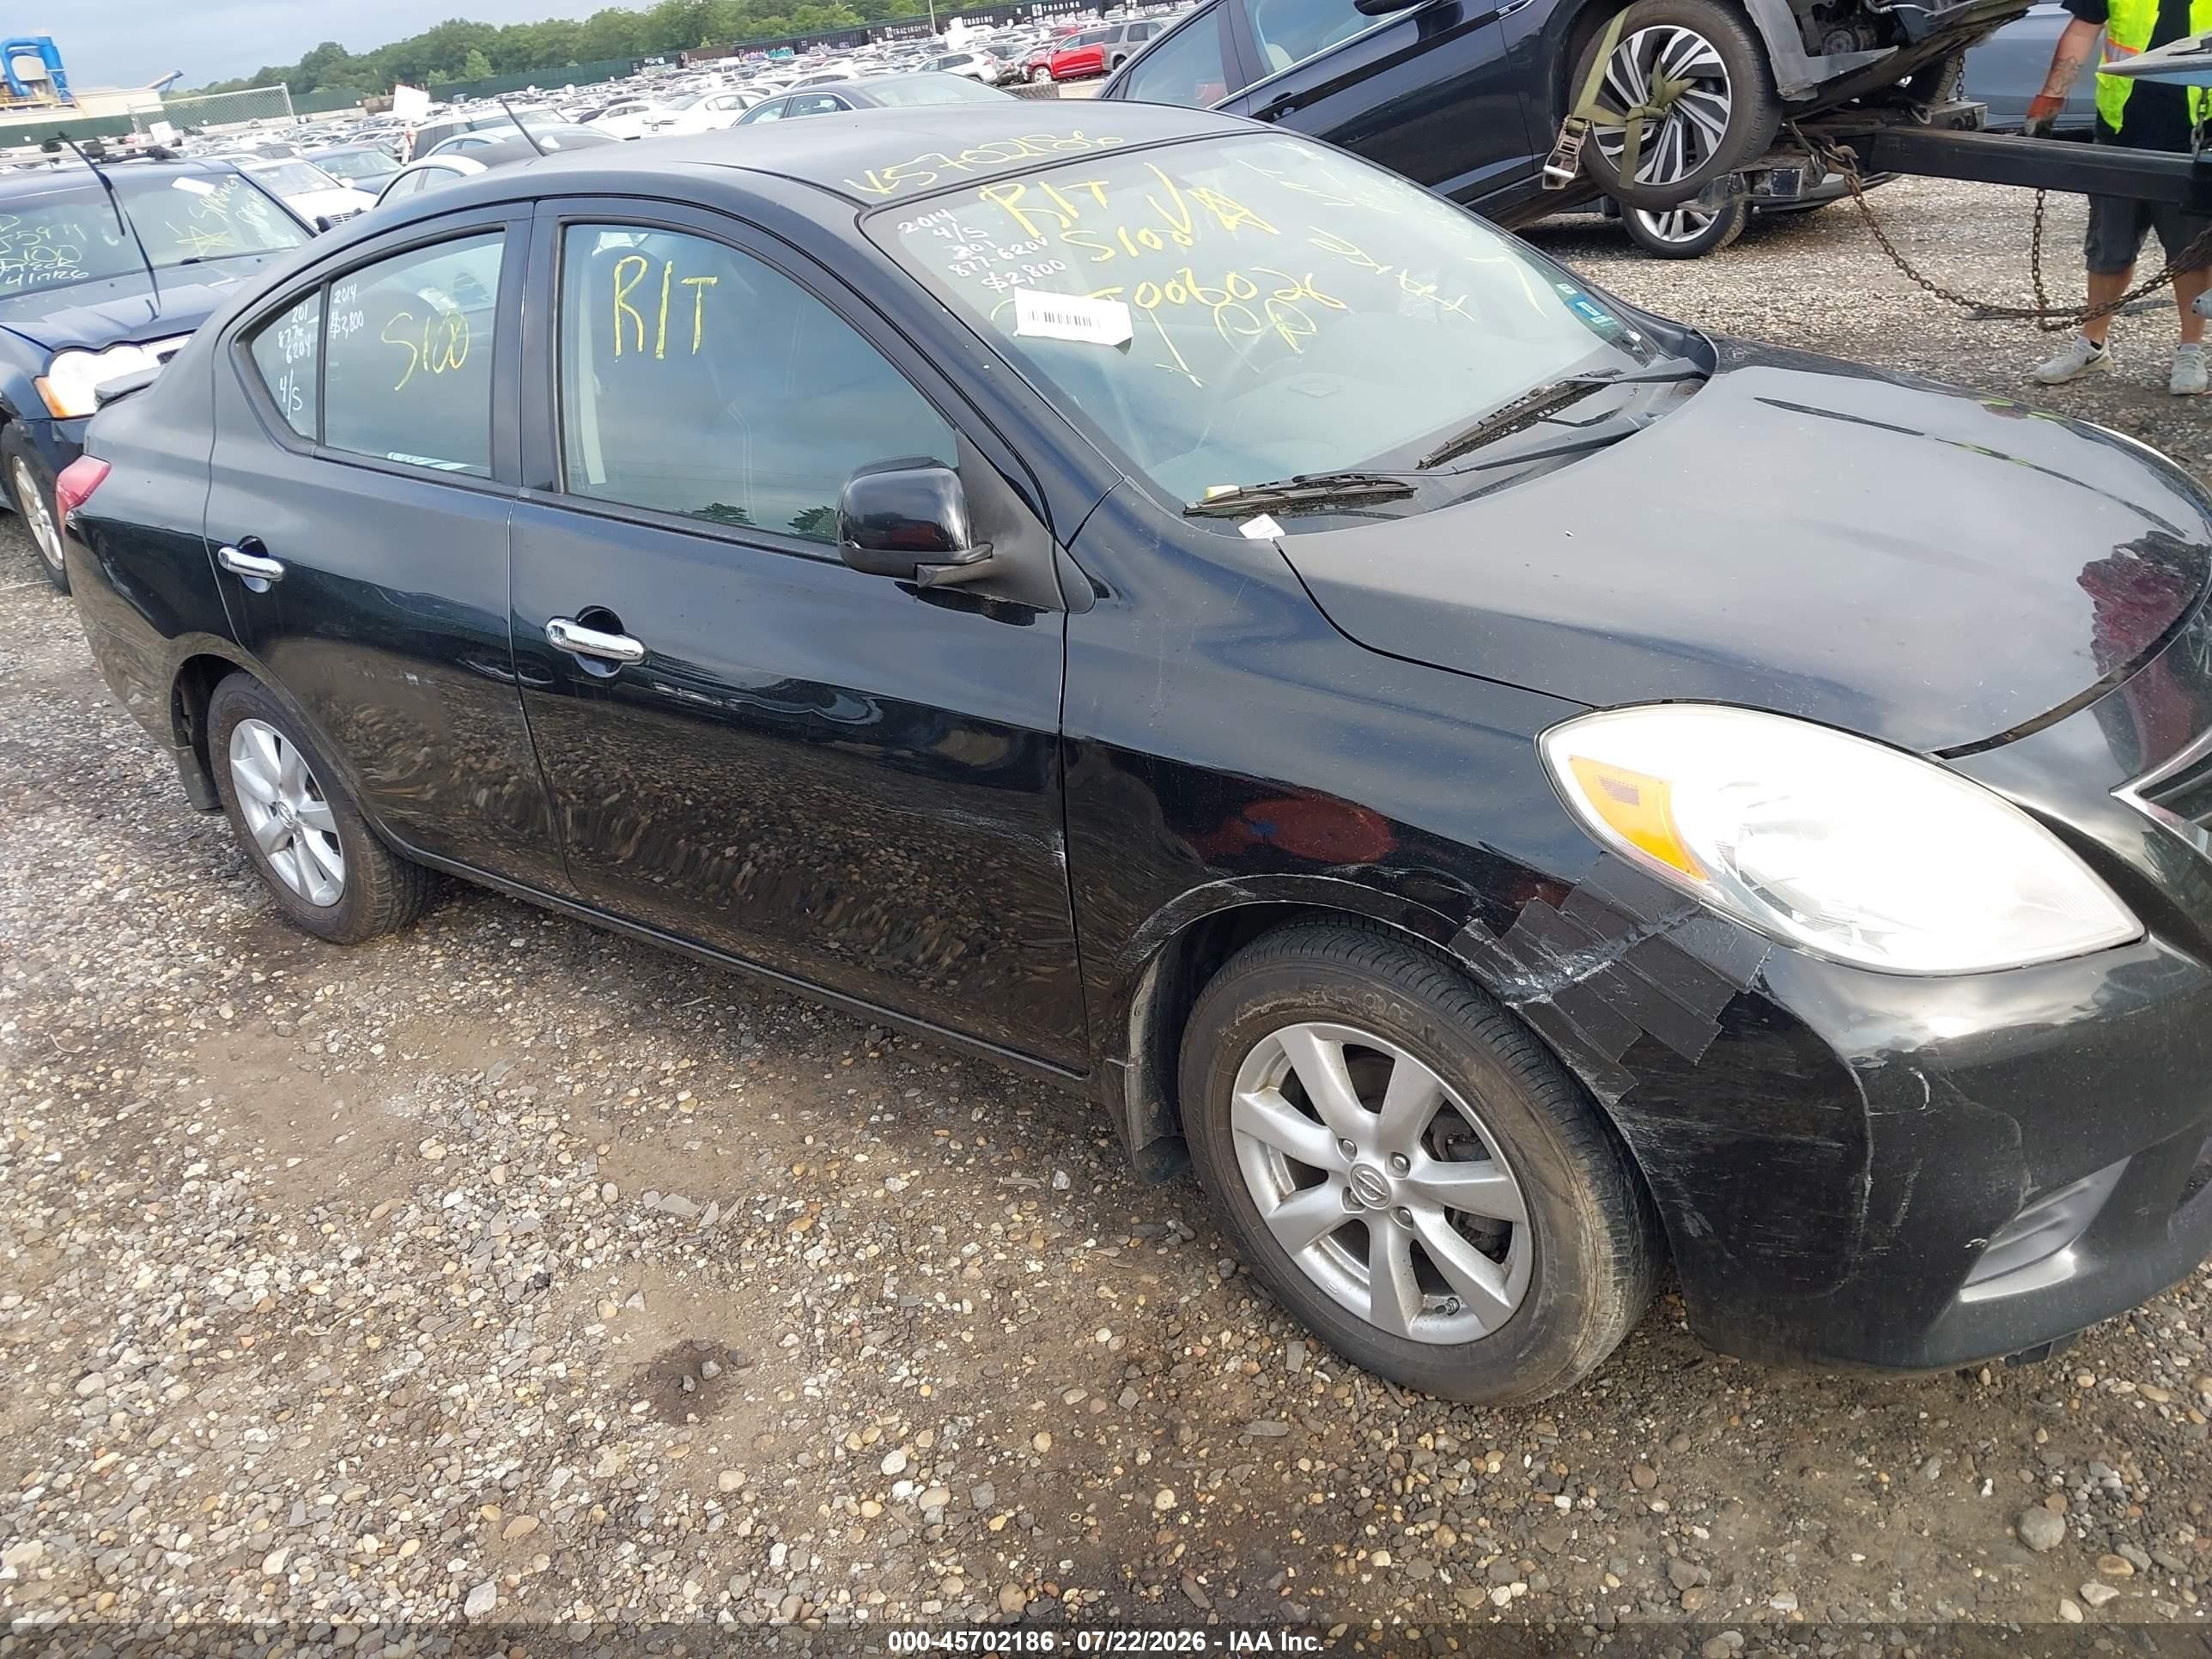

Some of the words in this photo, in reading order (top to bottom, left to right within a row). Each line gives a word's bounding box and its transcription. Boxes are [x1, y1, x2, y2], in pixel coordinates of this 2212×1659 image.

[897, 209, 958, 234] 2014
[981, 259, 1066, 294] $2,800
[334, 283, 358, 303] 2014
[292, 304, 308, 324] 201
[286, 333, 312, 364] 6204
[279, 368, 303, 420] 4/S
